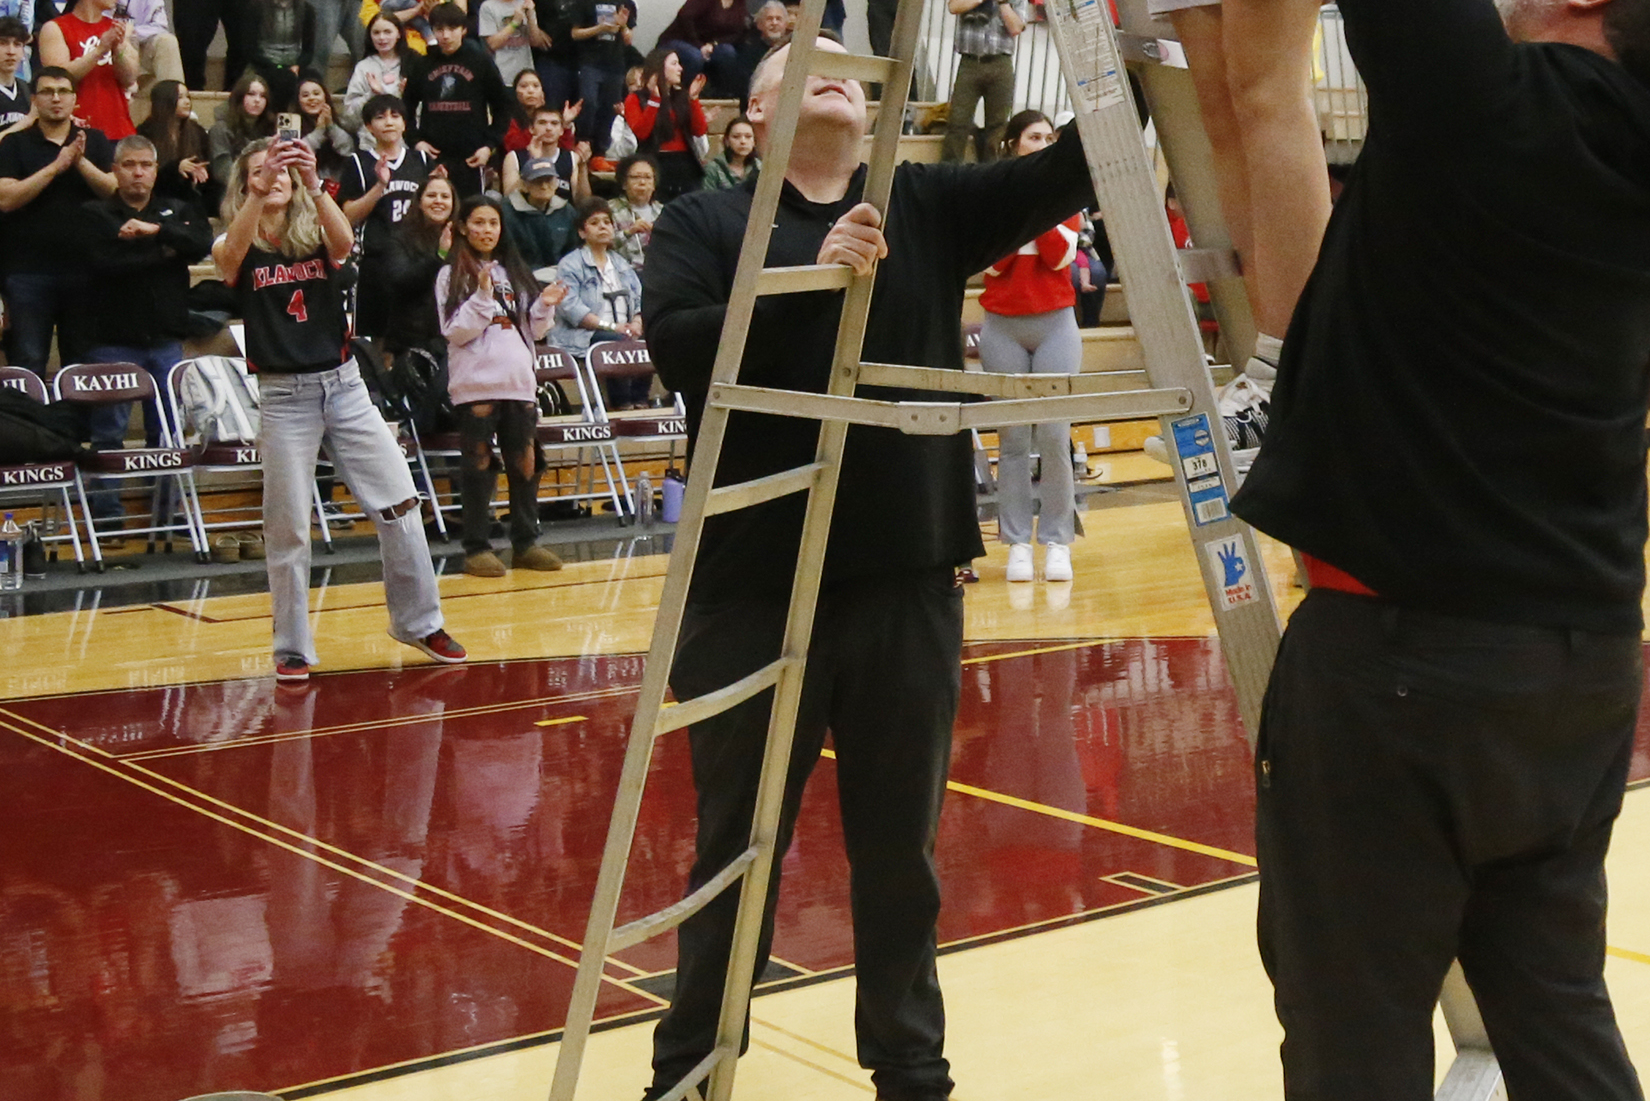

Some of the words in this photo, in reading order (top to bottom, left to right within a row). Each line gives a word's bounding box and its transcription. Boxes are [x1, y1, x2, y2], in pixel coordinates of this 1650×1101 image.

[252, 259, 327, 291] KLAWOCK
[287, 289, 308, 322] 4
[535, 353, 563, 369] YHI
[601, 350, 650, 364] KAYH
[73, 373, 139, 391] KAYHI
[562, 425, 611, 441] KINGS
[658, 420, 687, 434] KIN
[125, 452, 182, 470] KINGS
[3, 466, 65, 484] KINGS
